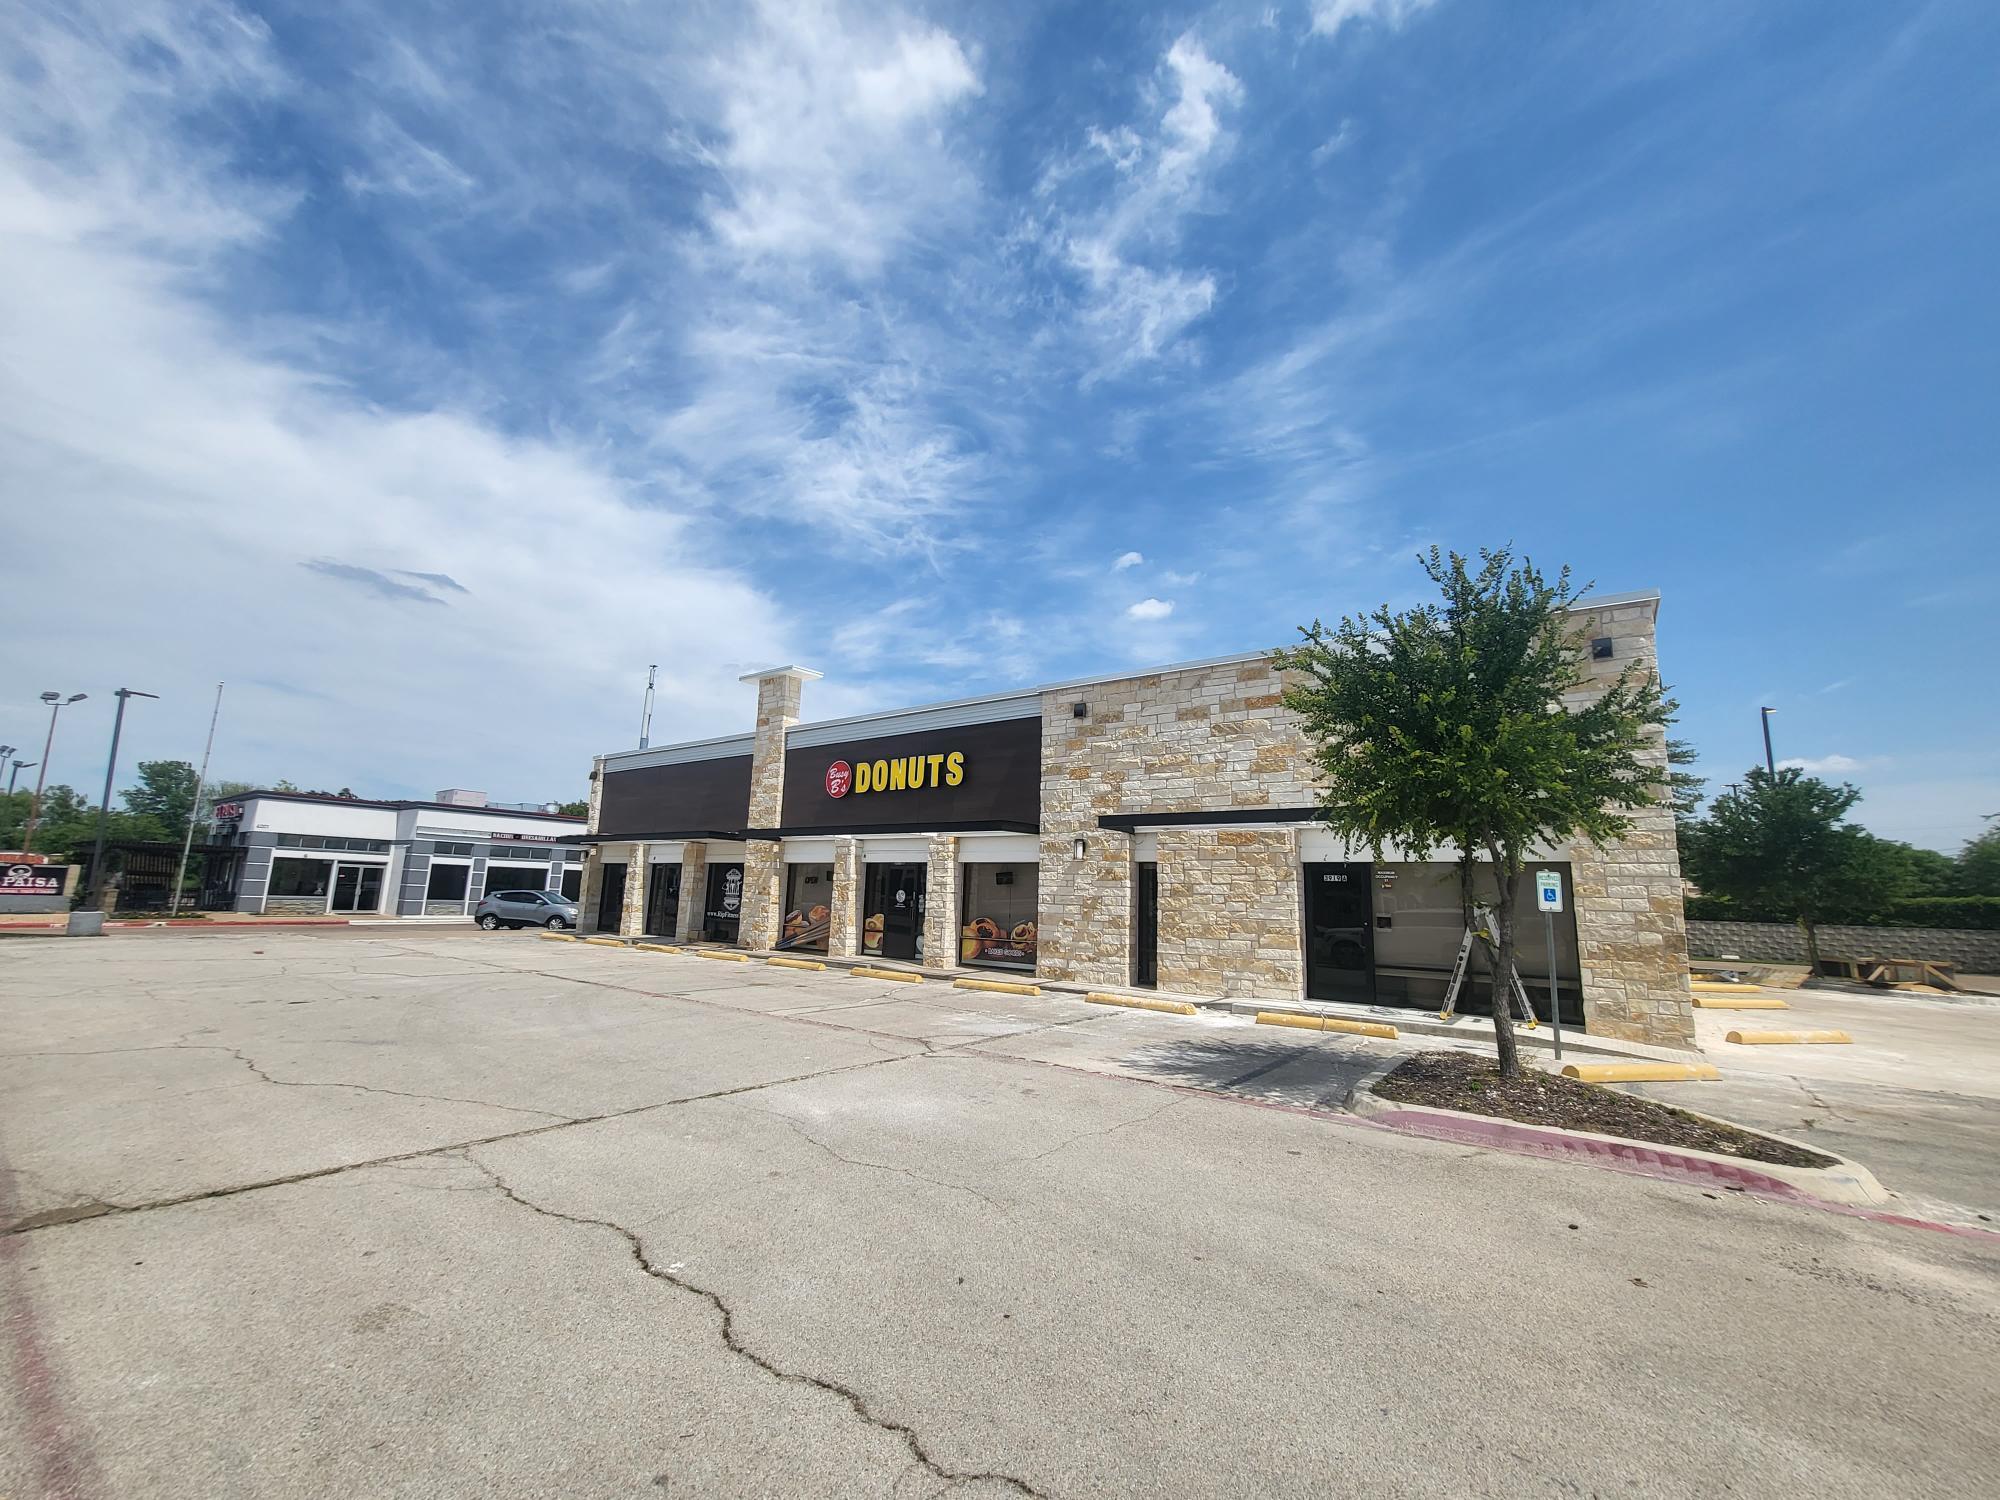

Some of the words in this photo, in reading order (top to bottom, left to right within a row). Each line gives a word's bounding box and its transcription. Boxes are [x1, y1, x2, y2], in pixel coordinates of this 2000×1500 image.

[829, 767, 849, 779] Busy
[855, 751, 965, 794] DONUTS
[831, 778, 847, 793] B's
[1, 876, 60, 887] PAISA
